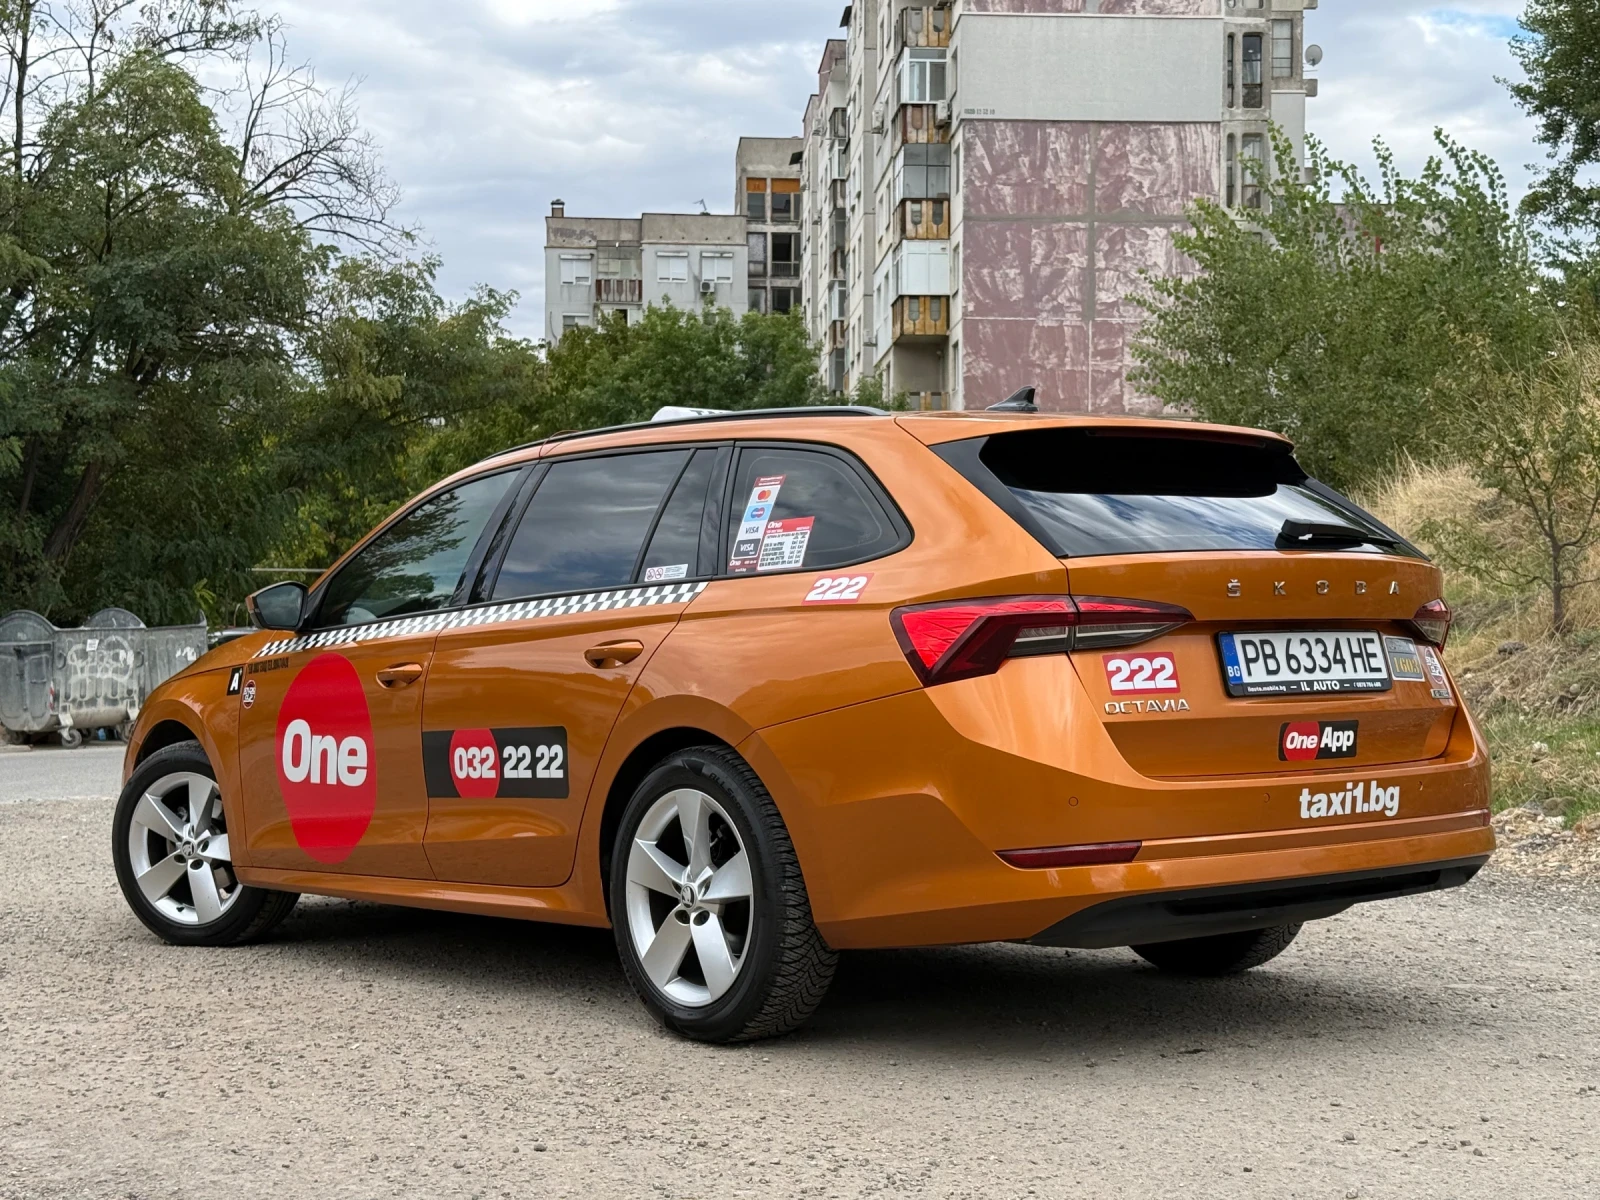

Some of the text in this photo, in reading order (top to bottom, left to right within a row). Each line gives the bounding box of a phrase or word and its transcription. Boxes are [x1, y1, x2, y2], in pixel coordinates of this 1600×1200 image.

[745, 526, 760, 534] VISA
[767, 521, 783, 529] One
[740, 543, 755, 552] VISA
[805, 576, 868, 601] 222
[1227, 665, 1241, 678] BG
[1241, 638, 1281, 677] PB
[1285, 637, 1347, 675] 6334
[1347, 637, 1382, 673] HE
[1106, 656, 1177, 691] 222
[1300, 681, 1311, 691] IL
[1313, 680, 1340, 691] AUTO
[1104, 698, 1190, 714] OCTAVIA
[1285, 726, 1355, 752] One App
[281, 718, 368, 787] One
[453, 744, 564, 779] 032 22 22
[1299, 780, 1400, 819] taxi1.bg
